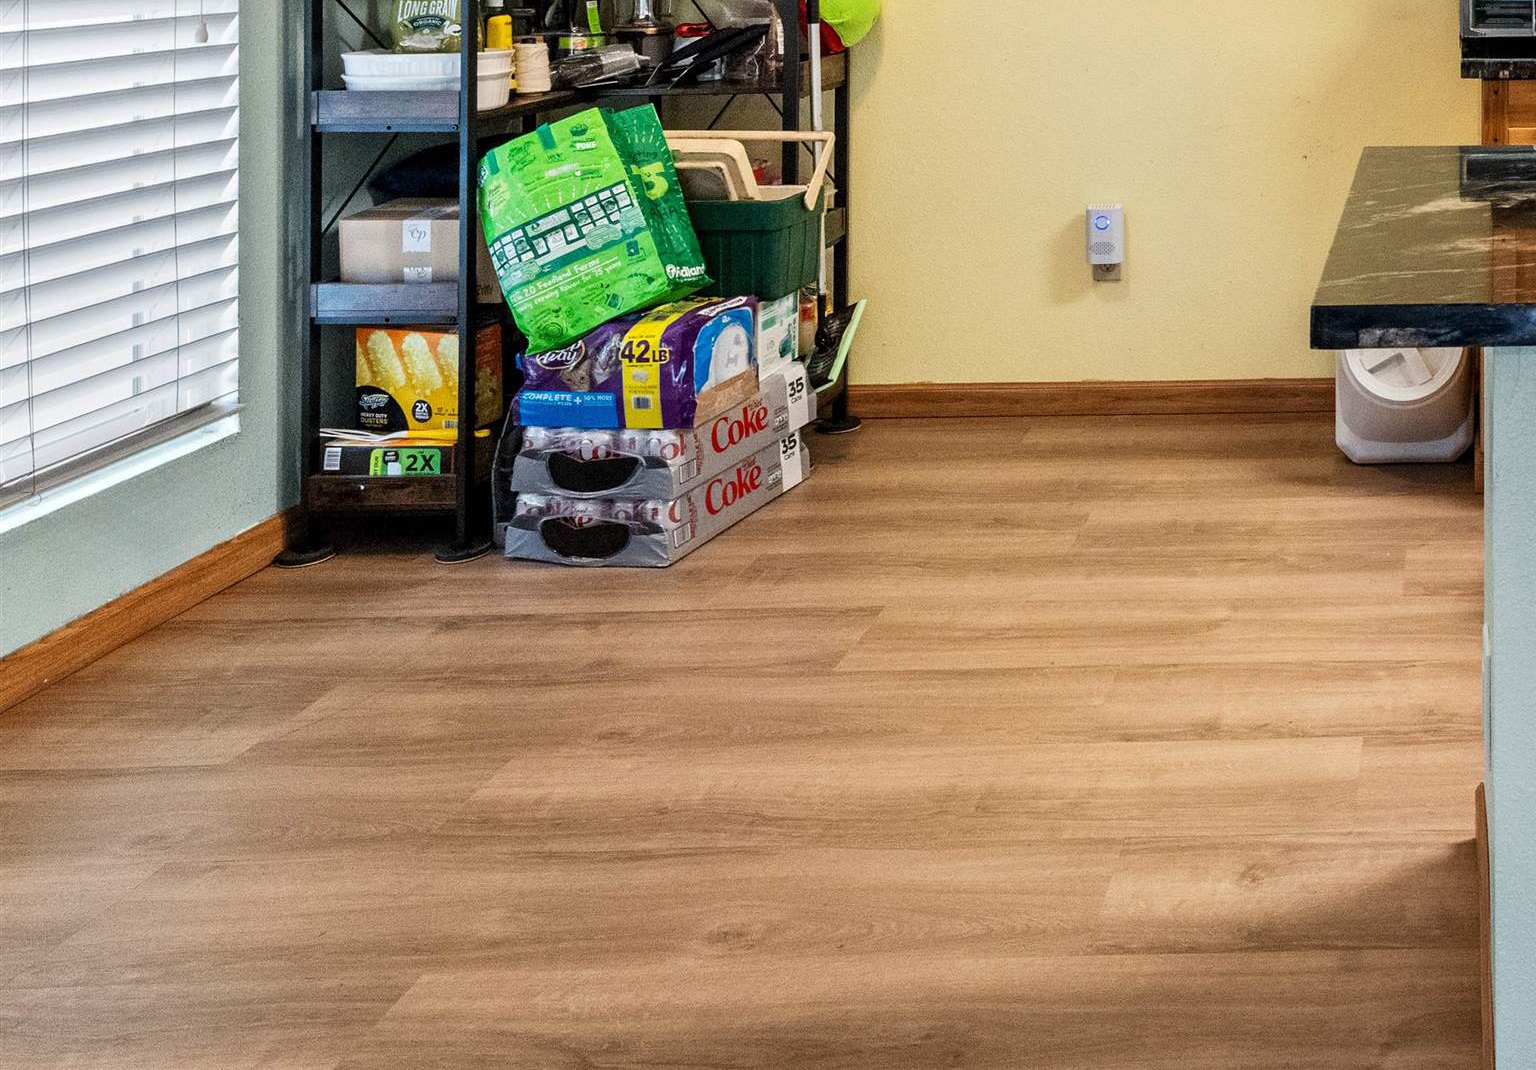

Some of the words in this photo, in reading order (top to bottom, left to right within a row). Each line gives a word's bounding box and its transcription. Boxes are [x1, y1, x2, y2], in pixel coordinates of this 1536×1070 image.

[397, 0, 428, 23] LONG
[620, 339, 650, 363] 42
[652, 350, 668, 362] LB
[523, 393, 572, 401] COMPLETE
[788, 377, 804, 397] 35
[415, 402, 428, 412] 2X
[711, 406, 768, 453] Coke
[781, 433, 797, 454] 35
[405, 454, 435, 472] 2X
[705, 465, 762, 515] Coke
